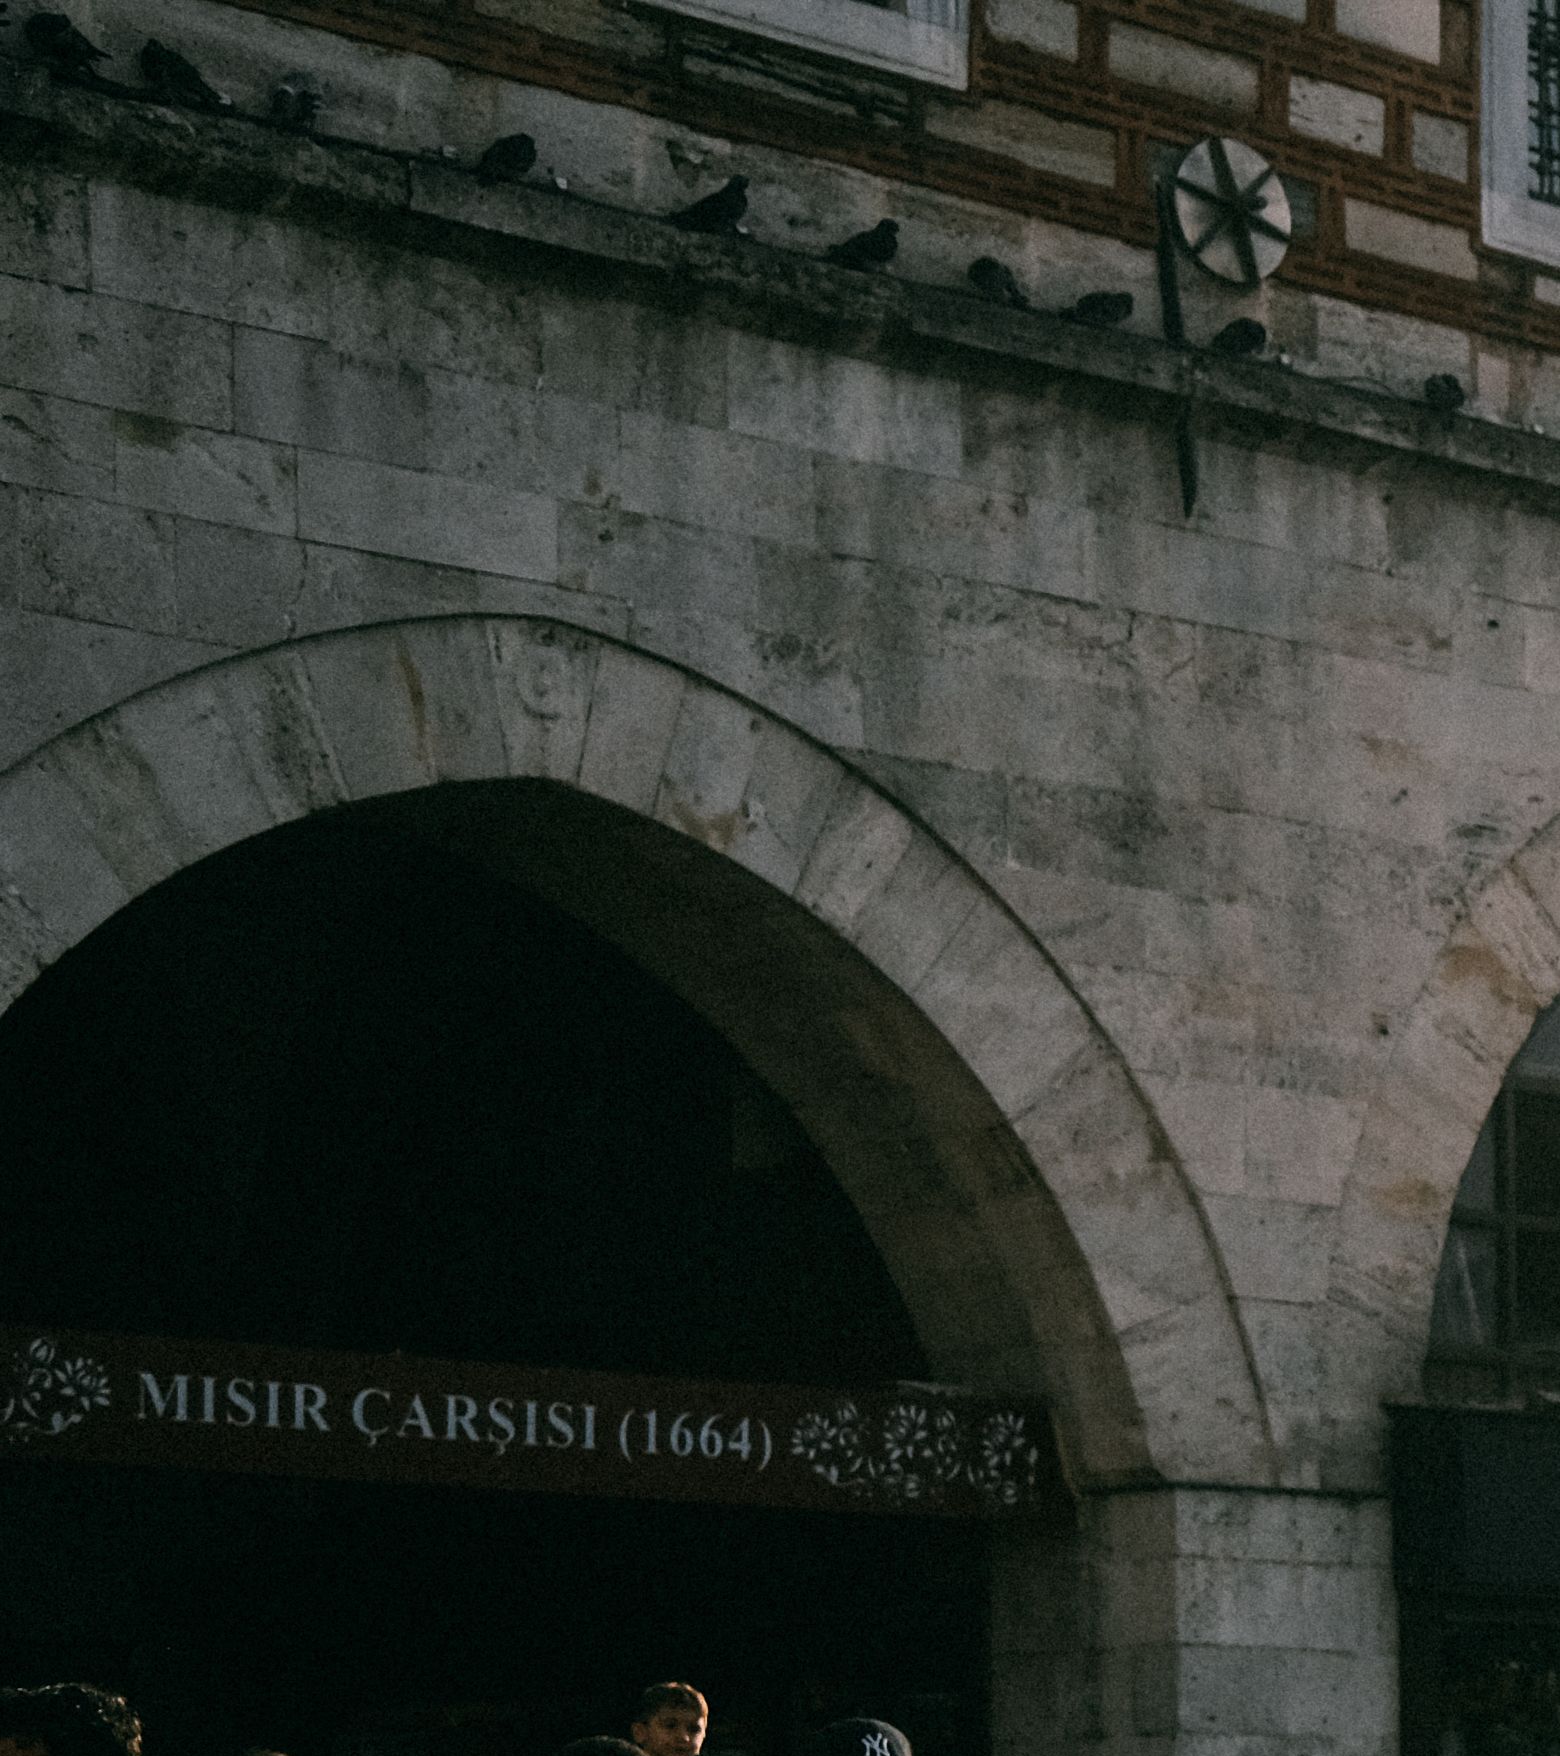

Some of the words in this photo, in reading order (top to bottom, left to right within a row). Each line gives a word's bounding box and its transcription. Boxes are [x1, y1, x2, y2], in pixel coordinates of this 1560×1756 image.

[137, 1370, 332, 1432] MISIR
[351, 1387, 598, 1456] ÇARŞISI
[618, 1407, 773, 1471] (1664)
